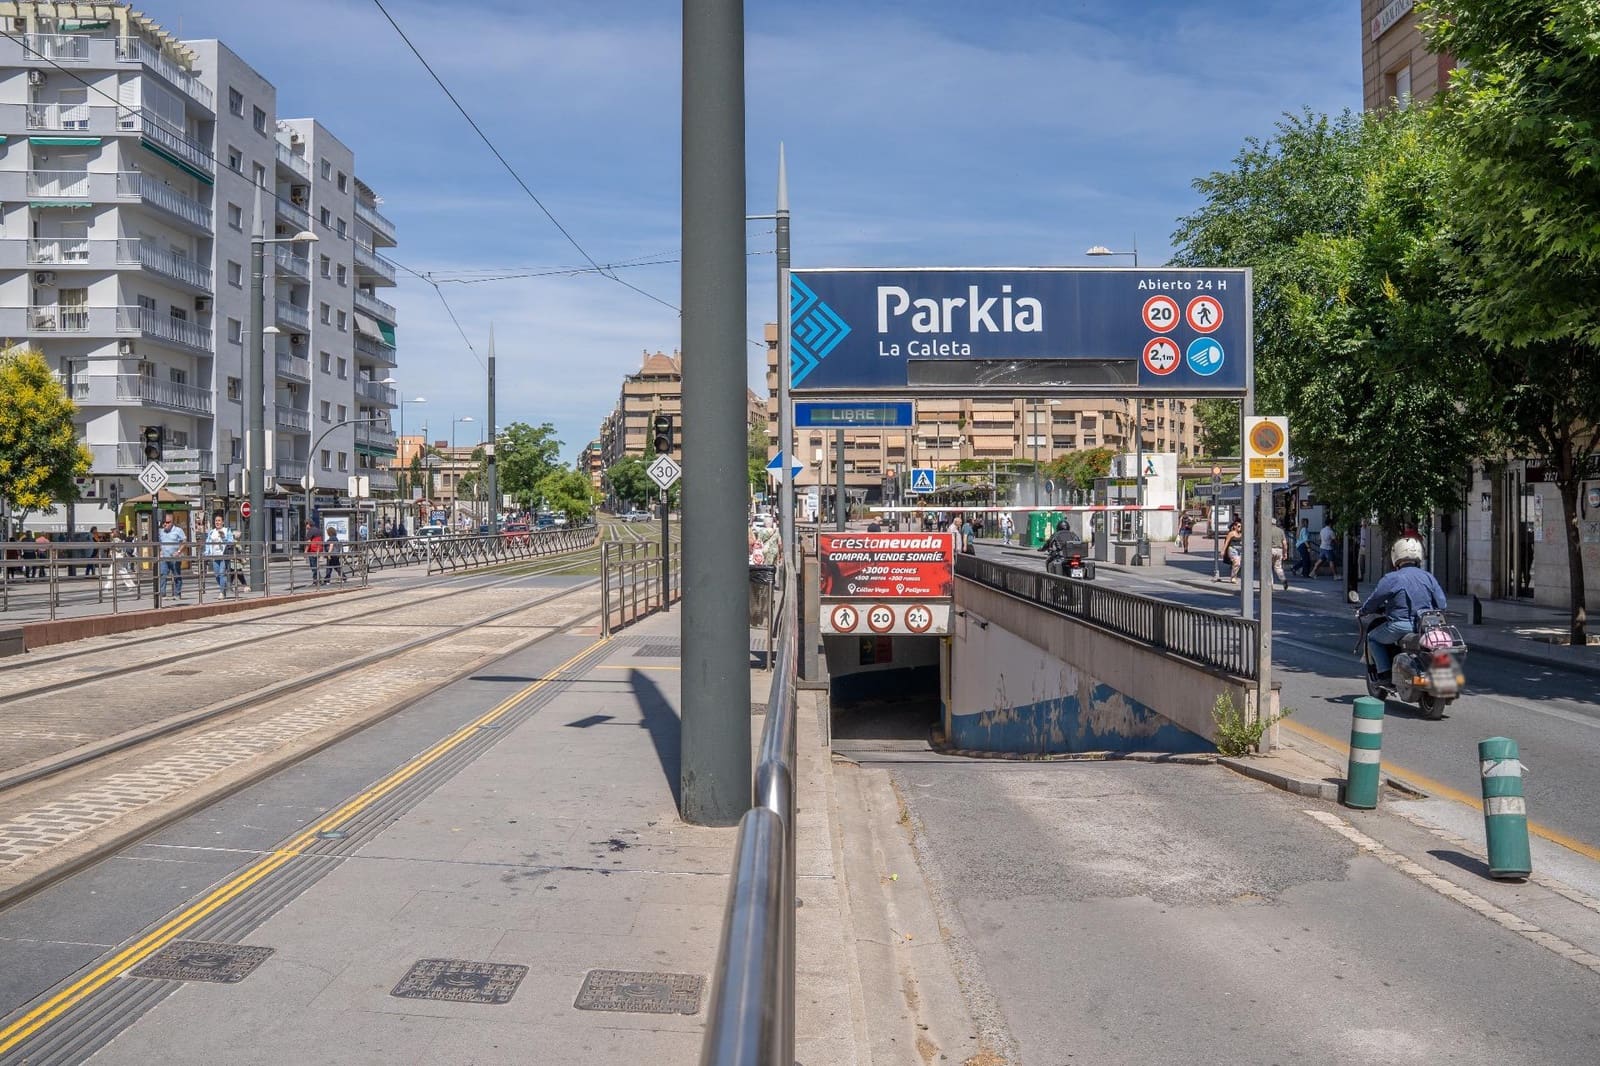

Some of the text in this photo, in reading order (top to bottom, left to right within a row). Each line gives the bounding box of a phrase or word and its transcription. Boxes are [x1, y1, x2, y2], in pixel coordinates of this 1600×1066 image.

[1138, 279, 1227, 290] Abierto 24 H
[877, 285, 1043, 333] Parkia
[1150, 307, 1172, 321] 20
[879, 339, 971, 356] La Caleta
[1150, 349, 1174, 361] 2,1m
[831, 409, 875, 420] LIBRE
[146, 473, 157, 483] 15
[656, 466, 673, 478] 30
[831, 536, 942, 549] crestanevada
[829, 551, 944, 562] COMPRA, VENDE SONRÍE.
[873, 613, 890, 623] 20
